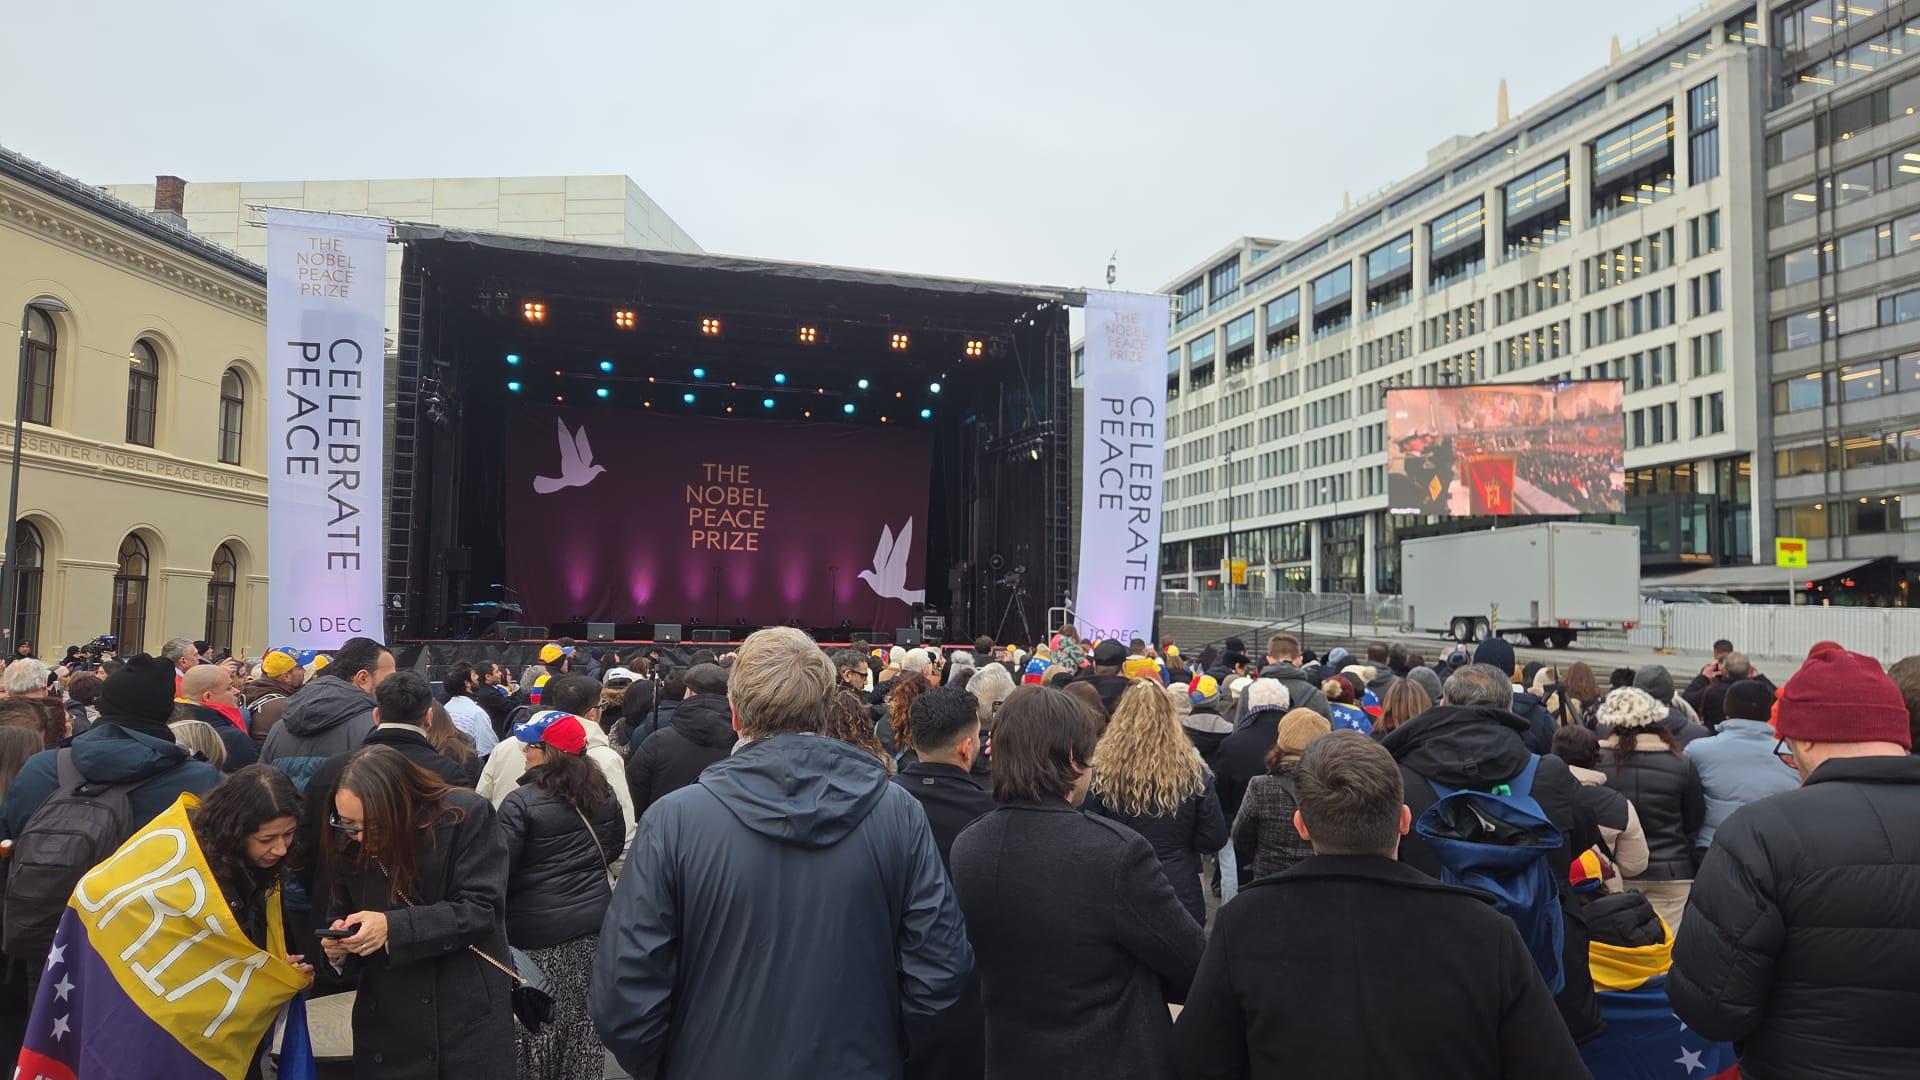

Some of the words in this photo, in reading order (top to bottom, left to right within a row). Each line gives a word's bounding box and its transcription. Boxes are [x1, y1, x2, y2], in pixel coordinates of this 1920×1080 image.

[309, 237, 342, 252] THE
[296, 252, 356, 269] NOBEL
[298, 268, 353, 284] PEACE
[301, 282, 349, 298] PRIZE
[1113, 311, 1137, 323] THE
[1105, 324, 1149, 338] NOBEL
[1107, 336, 1148, 350] PEACE
[1109, 350, 1144, 361] PRIZE
[286, 341, 321, 475] PEACE
[327, 338, 363, 571] CELEBRATE
[1099, 397, 1124, 511] PEACE
[104, 452, 153, 472] NOBEL
[156, 463, 200, 481] PEACE
[203, 471, 250, 489] CENTER
[702, 463, 750, 484] THE
[686, 484, 769, 507] NOBEL
[1124, 396, 1155, 591] CELEBRATE
[689, 507, 766, 529] PEACE
[692, 530, 758, 551] PRIZE
[289, 617, 312, 633] 10
[319, 617, 362, 633] DEC
[1089, 629, 1105, 640] 10
[1110, 629, 1139, 642] DEC
